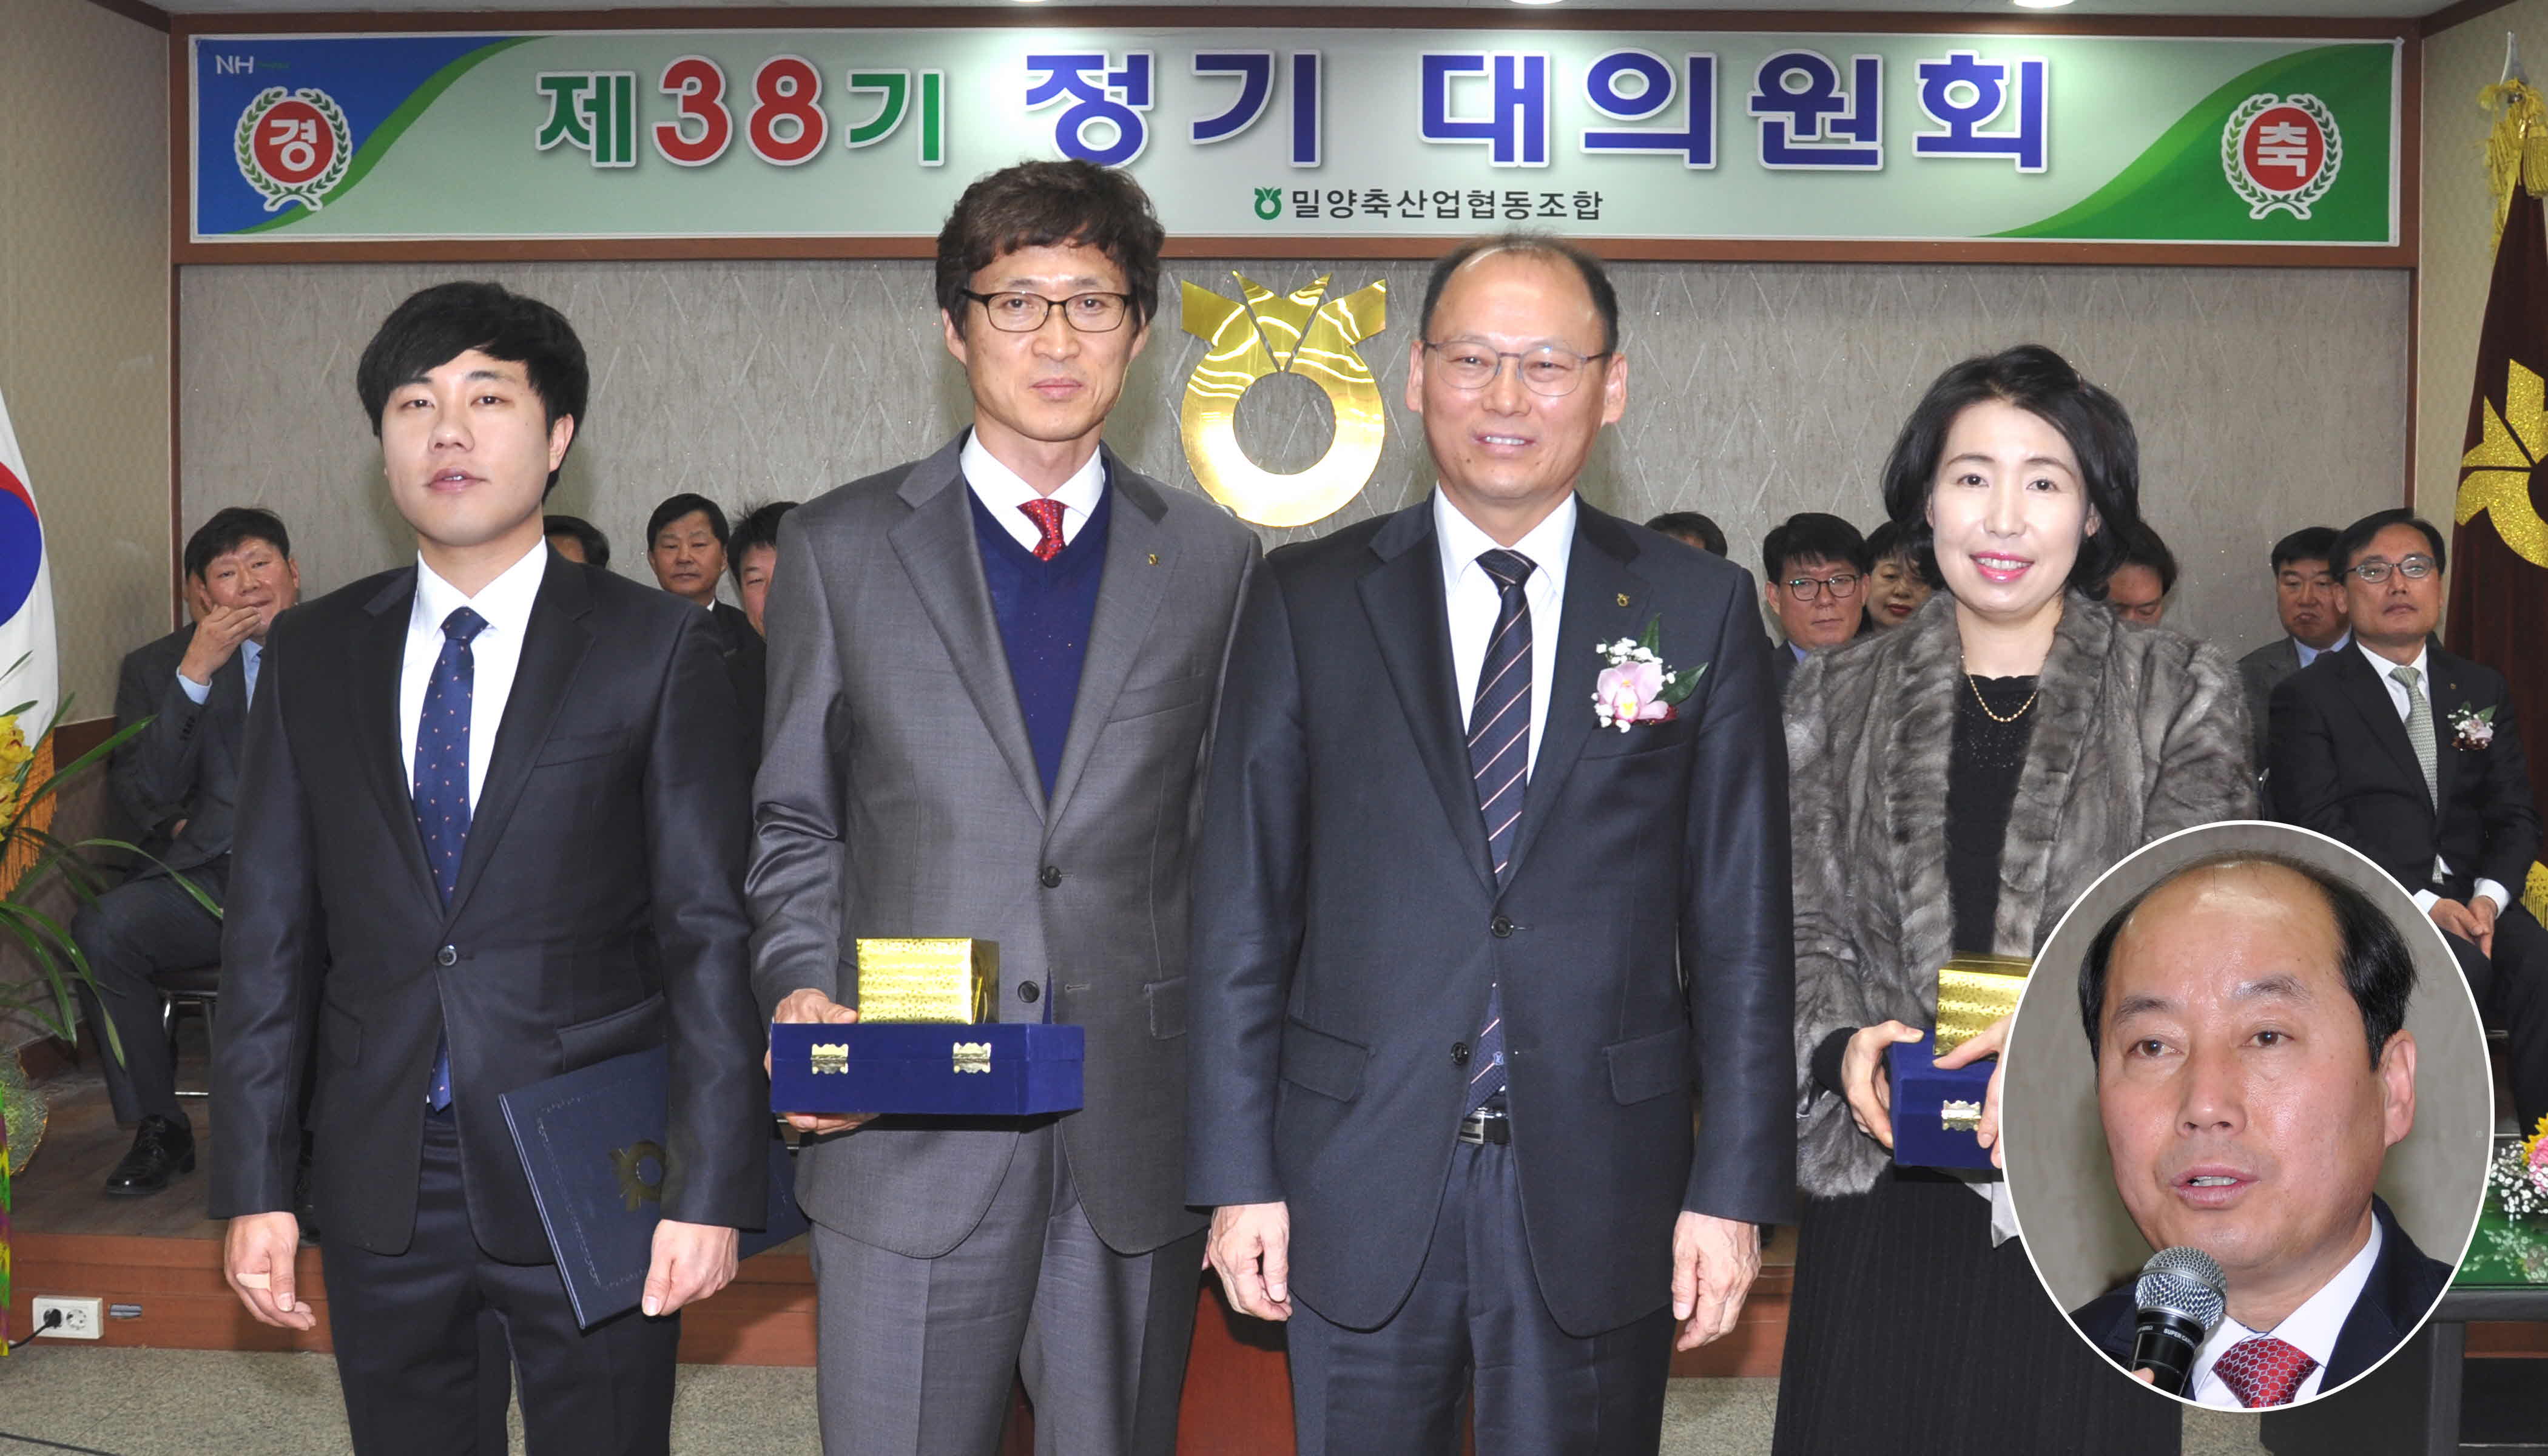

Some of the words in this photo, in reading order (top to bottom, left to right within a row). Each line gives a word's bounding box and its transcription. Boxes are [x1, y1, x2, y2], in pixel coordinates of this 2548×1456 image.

[215, 55, 254, 74] NH
[538, 56, 941, 163] 제38기
[1025, 53, 1317, 167] 정기
[1421, 51, 2044, 169] 대의원회
[269, 119, 317, 172] 경
[2257, 121, 2308, 177] 축
[1292, 189, 1603, 220] 밀양축산업협동조합
